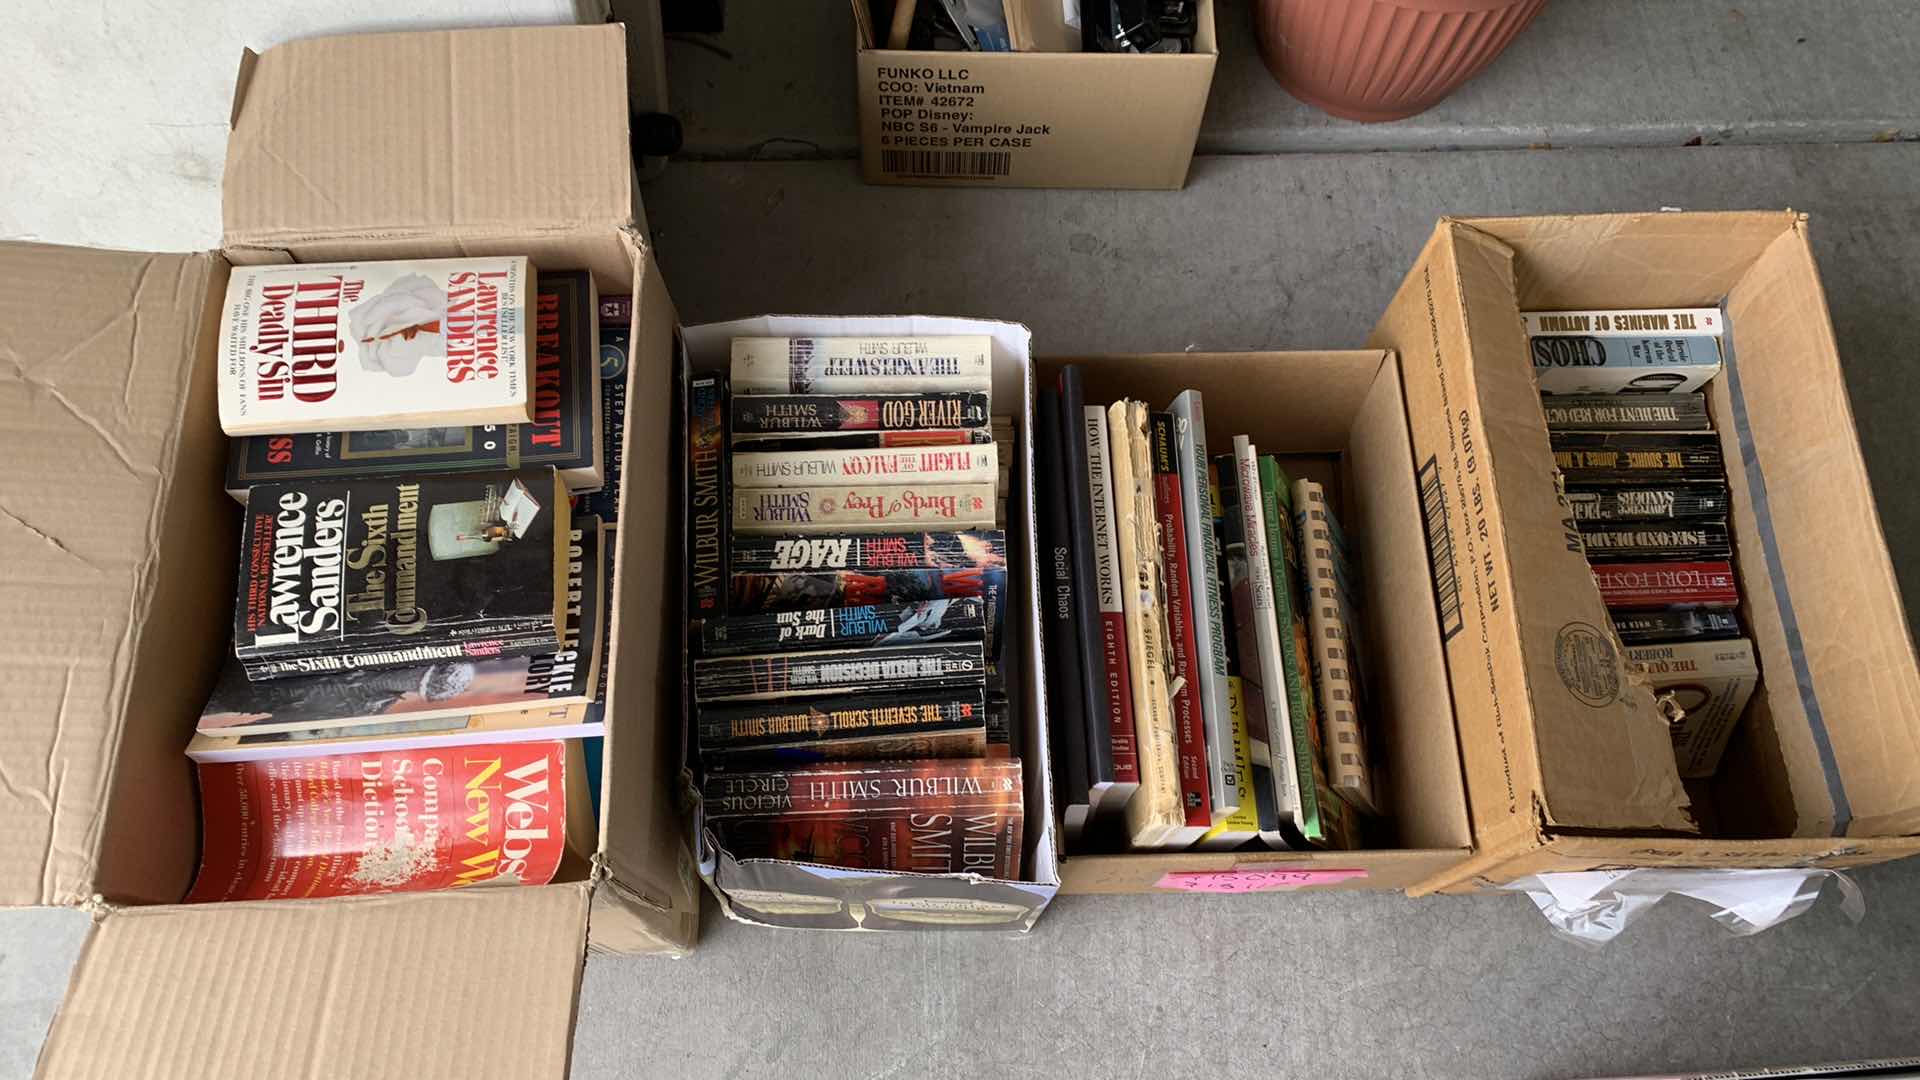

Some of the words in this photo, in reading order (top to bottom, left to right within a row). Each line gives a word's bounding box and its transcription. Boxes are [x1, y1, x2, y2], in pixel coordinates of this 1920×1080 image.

[877, 67, 934, 80] FUNKO
[938, 68, 969, 80] LLC
[878, 81, 919, 94] COO:
[925, 81, 985, 94] Vietnam
[879, 95, 925, 107] ITEM#
[930, 95, 975, 107] 42672
[881, 108, 914, 120] POP
[918, 108, 974, 122] Disney:
[881, 121, 915, 133] NBC
[919, 122, 940, 134] S6
[952, 122, 1012, 137] Vampire
[1016, 123, 1050, 136] Jack
[881, 136, 890, 147] 6
[893, 136, 948, 148] PIECES
[953, 136, 984, 148] PER
[990, 137, 1032, 148] CASE
[342, 279, 365, 303] The
[248, 283, 296, 360] Deadly
[445, 271, 476, 385] SANDERS
[475, 269, 508, 380] Lawrence
[1540, 316, 1591, 332] AUTUMN
[1594, 315, 1611, 331] OF
[1614, 314, 1670, 331] MARINES
[1674, 313, 1697, 330] THE
[290, 275, 345, 404] THIRD
[507, 325, 517, 343] NEW
[507, 345, 517, 368] YORK
[857, 341, 889, 355] SMITH
[893, 341, 929, 356] WILBUR
[531, 293, 561, 448] BREAKOUT
[823, 357, 874, 377] WEEP
[875, 356, 931, 376] ANGELS
[932, 356, 961, 376] THE
[256, 360, 291, 402] Sin
[1438, 368, 1449, 407] Island,
[613, 384, 625, 416] STEP
[764, 403, 818, 417] SMITH
[759, 415, 822, 429] WILBUR
[881, 400, 916, 428] GOD
[917, 400, 961, 428] RIVER
[1569, 408, 1592, 423] RED
[1593, 407, 1618, 422] FOR
[1621, 406, 1652, 422] HUNT
[1653, 406, 1680, 421] THE
[1087, 418, 1100, 448] HOW
[1458, 409, 1477, 474] (9.07kg)
[613, 423, 624, 471] ACTION
[1156, 421, 1170, 473] SCHAUM'S
[1195, 443, 1207, 469] YOUR
[755, 460, 791, 480] SMITH
[792, 460, 837, 481] WILBUR
[841, 452, 899, 476] FALCON
[918, 450, 972, 474] FLIGHT
[1089, 452, 1103, 479] THE
[1627, 452, 1664, 469] SOURCE
[1664, 452, 1685, 469] THE
[692, 447, 719, 506] SMITH
[1239, 458, 1253, 513] Microwave
[759, 491, 811, 508] SMITH
[841, 491, 885, 519] Prey
[902, 490, 958, 518] Birds
[1197, 471, 1211, 522] PERSONAL
[1471, 477, 1485, 515] LBS.
[1616, 491, 1675, 505] SANDERS
[753, 506, 812, 522] WILBUR
[886, 502, 902, 517] of
[1092, 483, 1109, 551] INTERNET
[1462, 510, 1472, 535] Box
[1477, 518, 1490, 542] 20
[346, 504, 389, 571] Sixth
[866, 537, 907, 553] SMITH
[1165, 513, 1178, 561] Probability,
[1244, 515, 1261, 556] Miracles
[1635, 531, 1698, 546] SECOND
[385, 483, 427, 634] Commandment
[693, 511, 719, 587] WILBUR
[769, 539, 852, 569] RAGE
[866, 551, 918, 568] WILBUR
[1201, 523, 1216, 576] FINANCIAL
[1467, 537, 1477, 565] P.O.
[1483, 543, 1495, 576] WT.
[254, 491, 307, 649] Lawrence
[299, 499, 345, 634] Sanders
[567, 528, 583, 617] ROBERT
[1053, 547, 1070, 580] Social
[1099, 554, 1113, 605] WORKS
[1168, 562, 1179, 598] Random
[1656, 570, 1702, 588] LORI
[247, 579, 260, 610] THIRD
[255, 580, 269, 628] NATIONAL
[346, 569, 386, 623] The
[1056, 585, 1071, 620] Chaos
[1206, 578, 1222, 620] FITNESS
[1472, 566, 1490, 644] Corporation,
[1486, 579, 1501, 613] NET
[246, 612, 257, 633] HIS
[776, 611, 801, 625] Sun
[789, 610, 825, 624] the
[838, 605, 877, 621] SMITH
[1172, 600, 1184, 640] Variables,
[778, 625, 789, 641] of
[788, 624, 826, 638] Dark
[839, 618, 889, 636] WILBUR
[1104, 620, 1117, 665] EIGHTH
[1143, 628, 1156, 670] SPIEGEL
[1175, 643, 1186, 658] and
[1210, 621, 1226, 677] PROGRAM
[1279, 617, 1299, 666] SNACKS
[280, 662, 298, 672] The
[297, 653, 341, 672] Sixth
[342, 644, 462, 669] Commandment
[548, 628, 580, 694] LECKIE
[914, 658, 944, 676] THE
[1671, 660, 1698, 672] THE
[818, 660, 879, 684] DECISION
[1285, 671, 1303, 698] AND
[1109, 672, 1122, 724] EDITION
[767, 714, 810, 733] WILBUR
[830, 709, 869, 729] SCROLL
[869, 706, 918, 726] SEVENTH
[920, 704, 943, 722] THE
[1180, 700, 1195, 744] Processes
[729, 718, 766, 738] SMITH
[1498, 731, 1505, 744] of
[1288, 702, 1317, 808] REFRESHMENTS
[281, 762, 292, 810] dictionary
[726, 777, 791, 793] CIRCLE
[892, 776, 983, 797] WILBUR
[1501, 748, 1516, 801] product
[295, 780, 305, 801] most
[464, 757, 502, 846] New
[722, 793, 793, 810] VICIOUS
[809, 780, 882, 800] SMITH
[271, 793, 282, 812] and
[1508, 805, 1516, 814] A
[240, 822, 250, 857] entries
